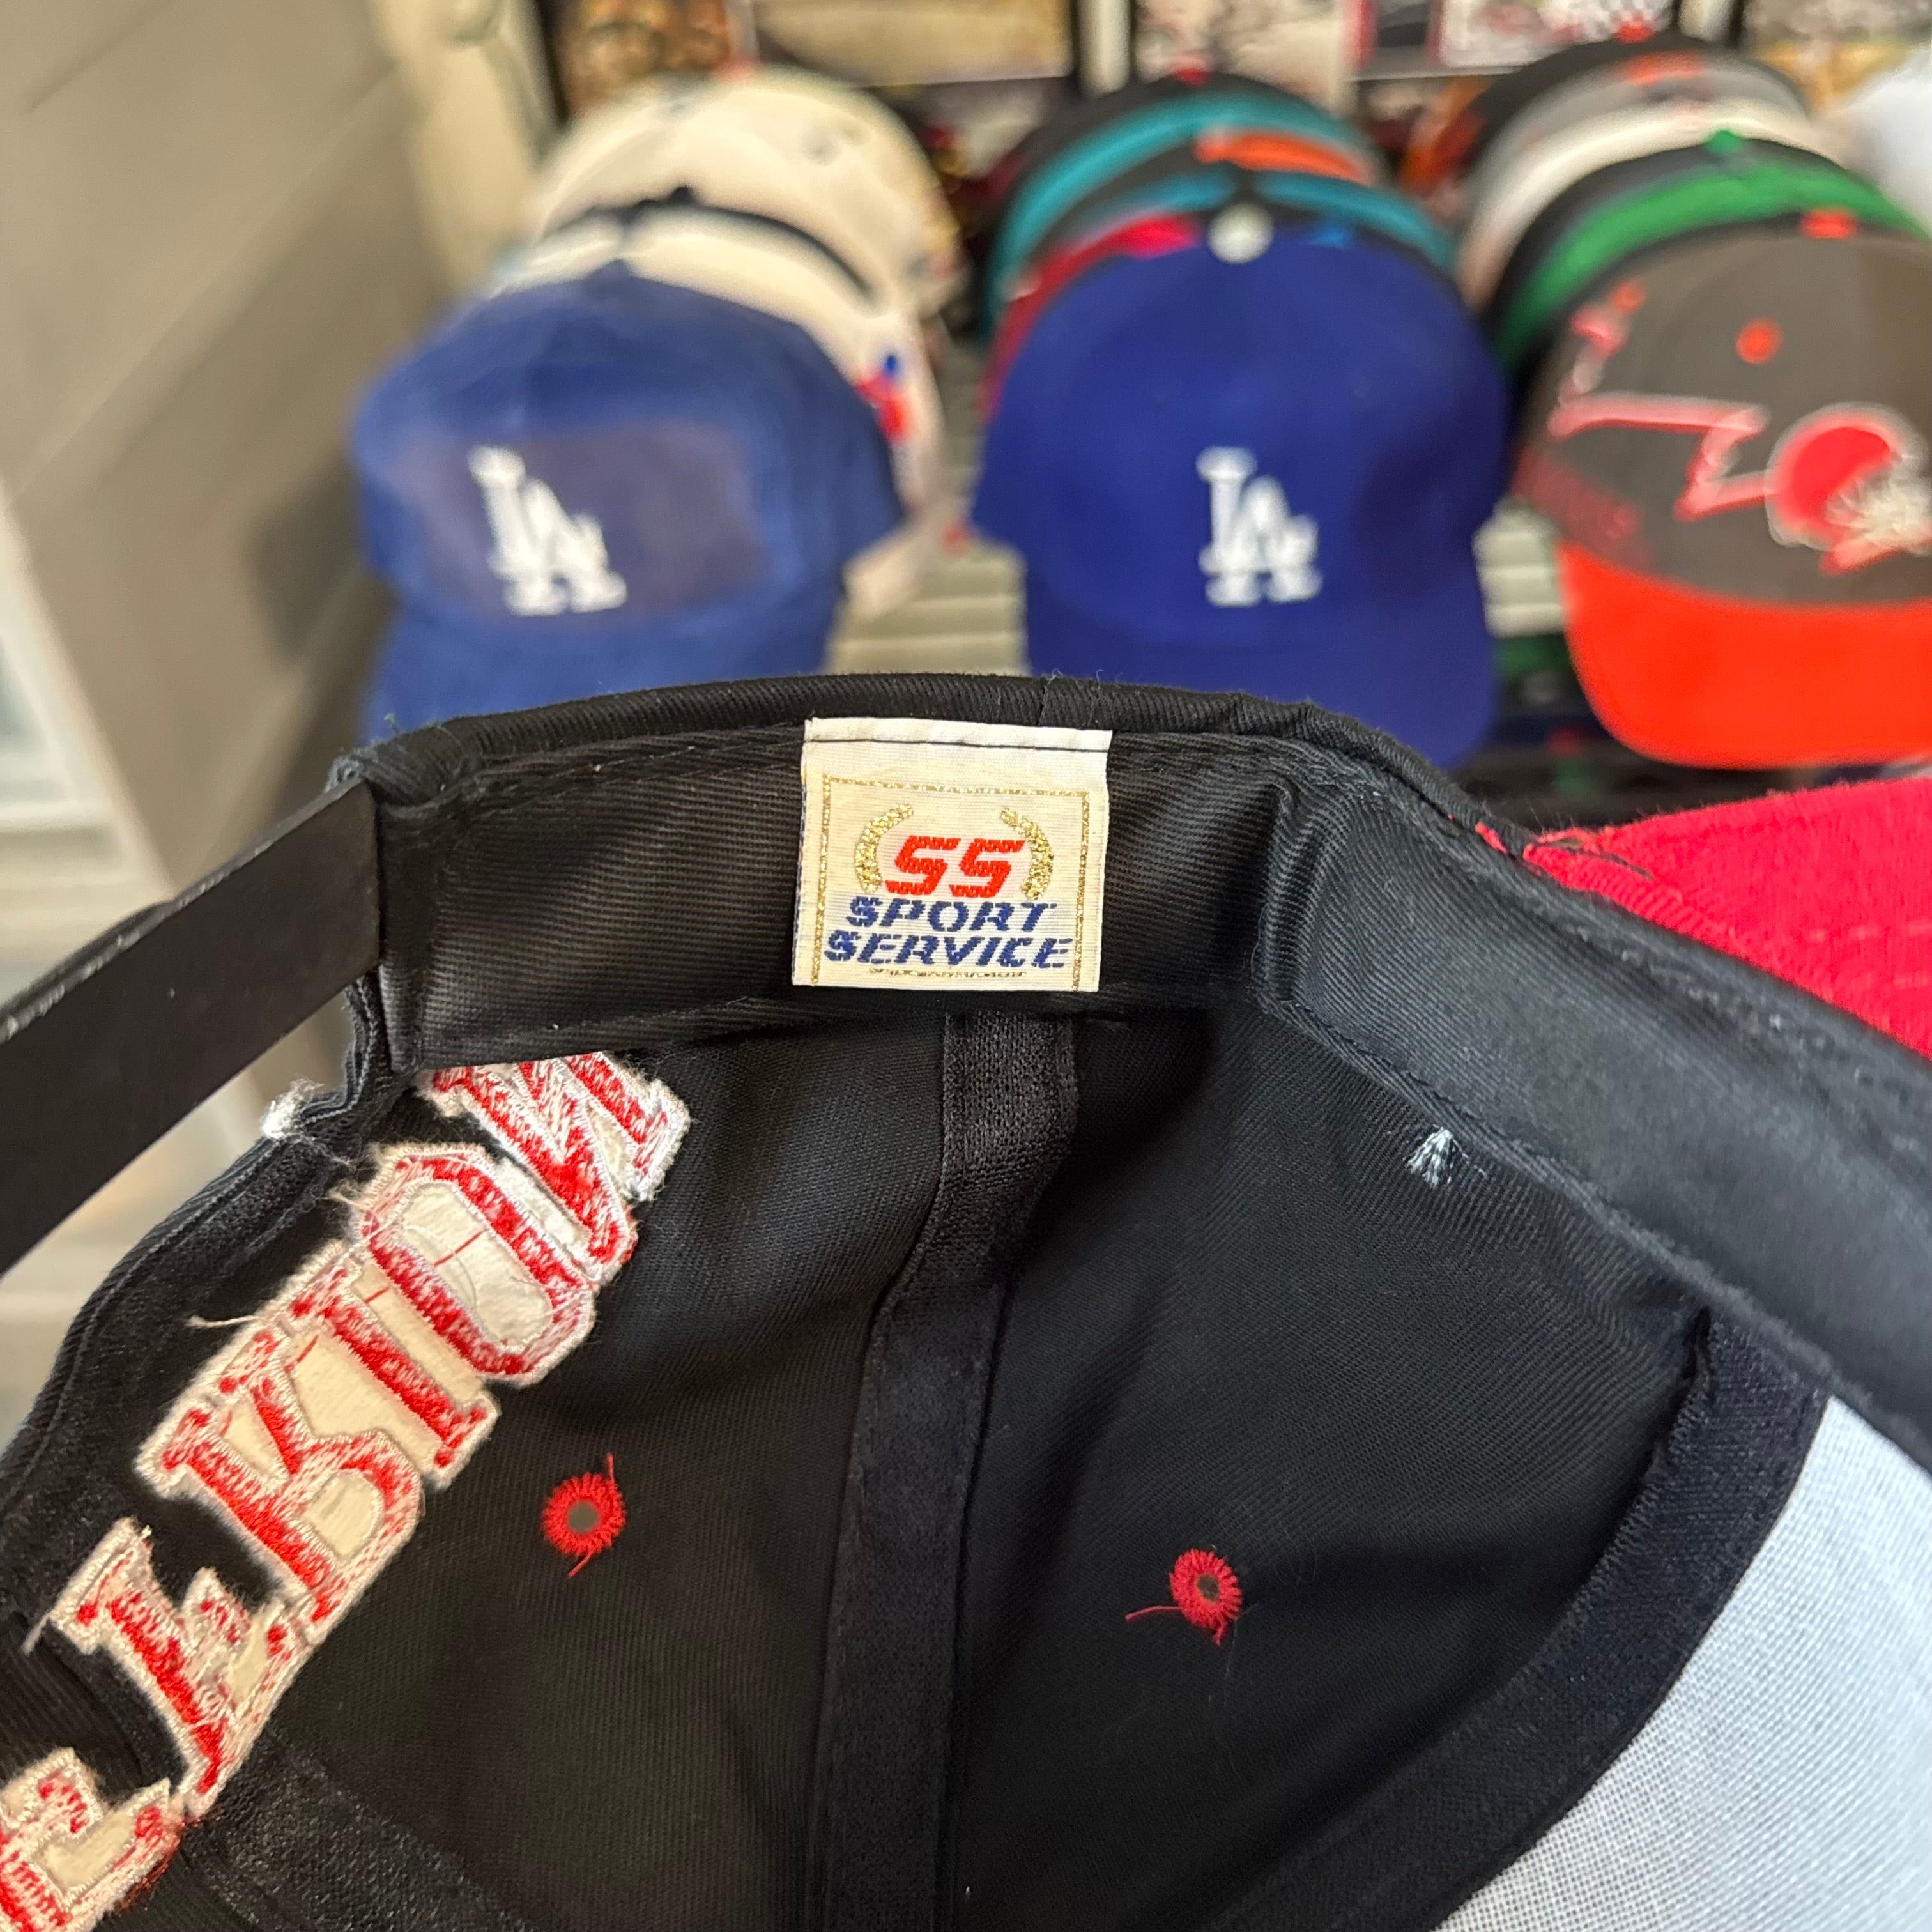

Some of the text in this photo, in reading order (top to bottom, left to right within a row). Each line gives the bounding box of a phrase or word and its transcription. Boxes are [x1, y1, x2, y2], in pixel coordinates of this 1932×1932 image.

[468, 445, 628, 617] LA
[1195, 445, 1324, 608] LA
[885, 836, 1025, 898] SS
[847, 896, 1058, 932] SPORT
[824, 930, 1073, 969] SERVICE
